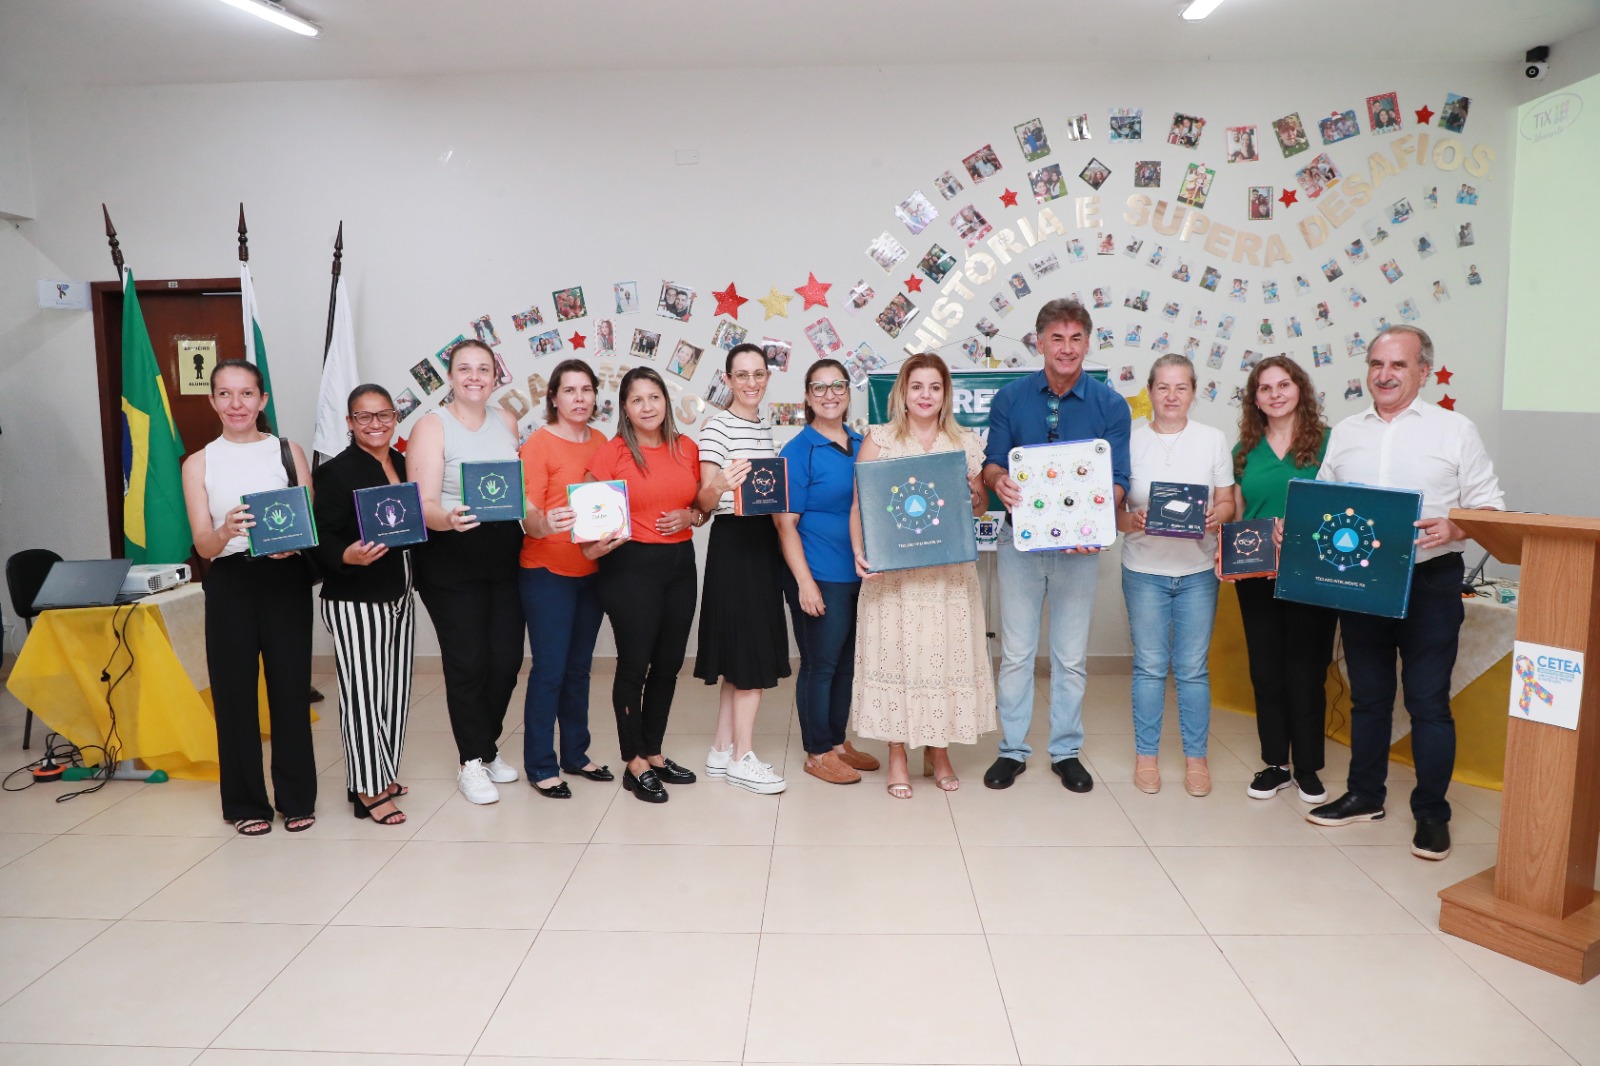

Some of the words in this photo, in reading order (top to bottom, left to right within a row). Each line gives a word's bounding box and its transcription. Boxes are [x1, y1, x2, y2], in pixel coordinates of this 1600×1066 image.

[903, 207, 1068, 356] HISTÓRIA
[1074, 195, 1104, 229] E
[1123, 193, 1292, 268] SUPERA
[1537, 656, 1581, 674] CETEA
